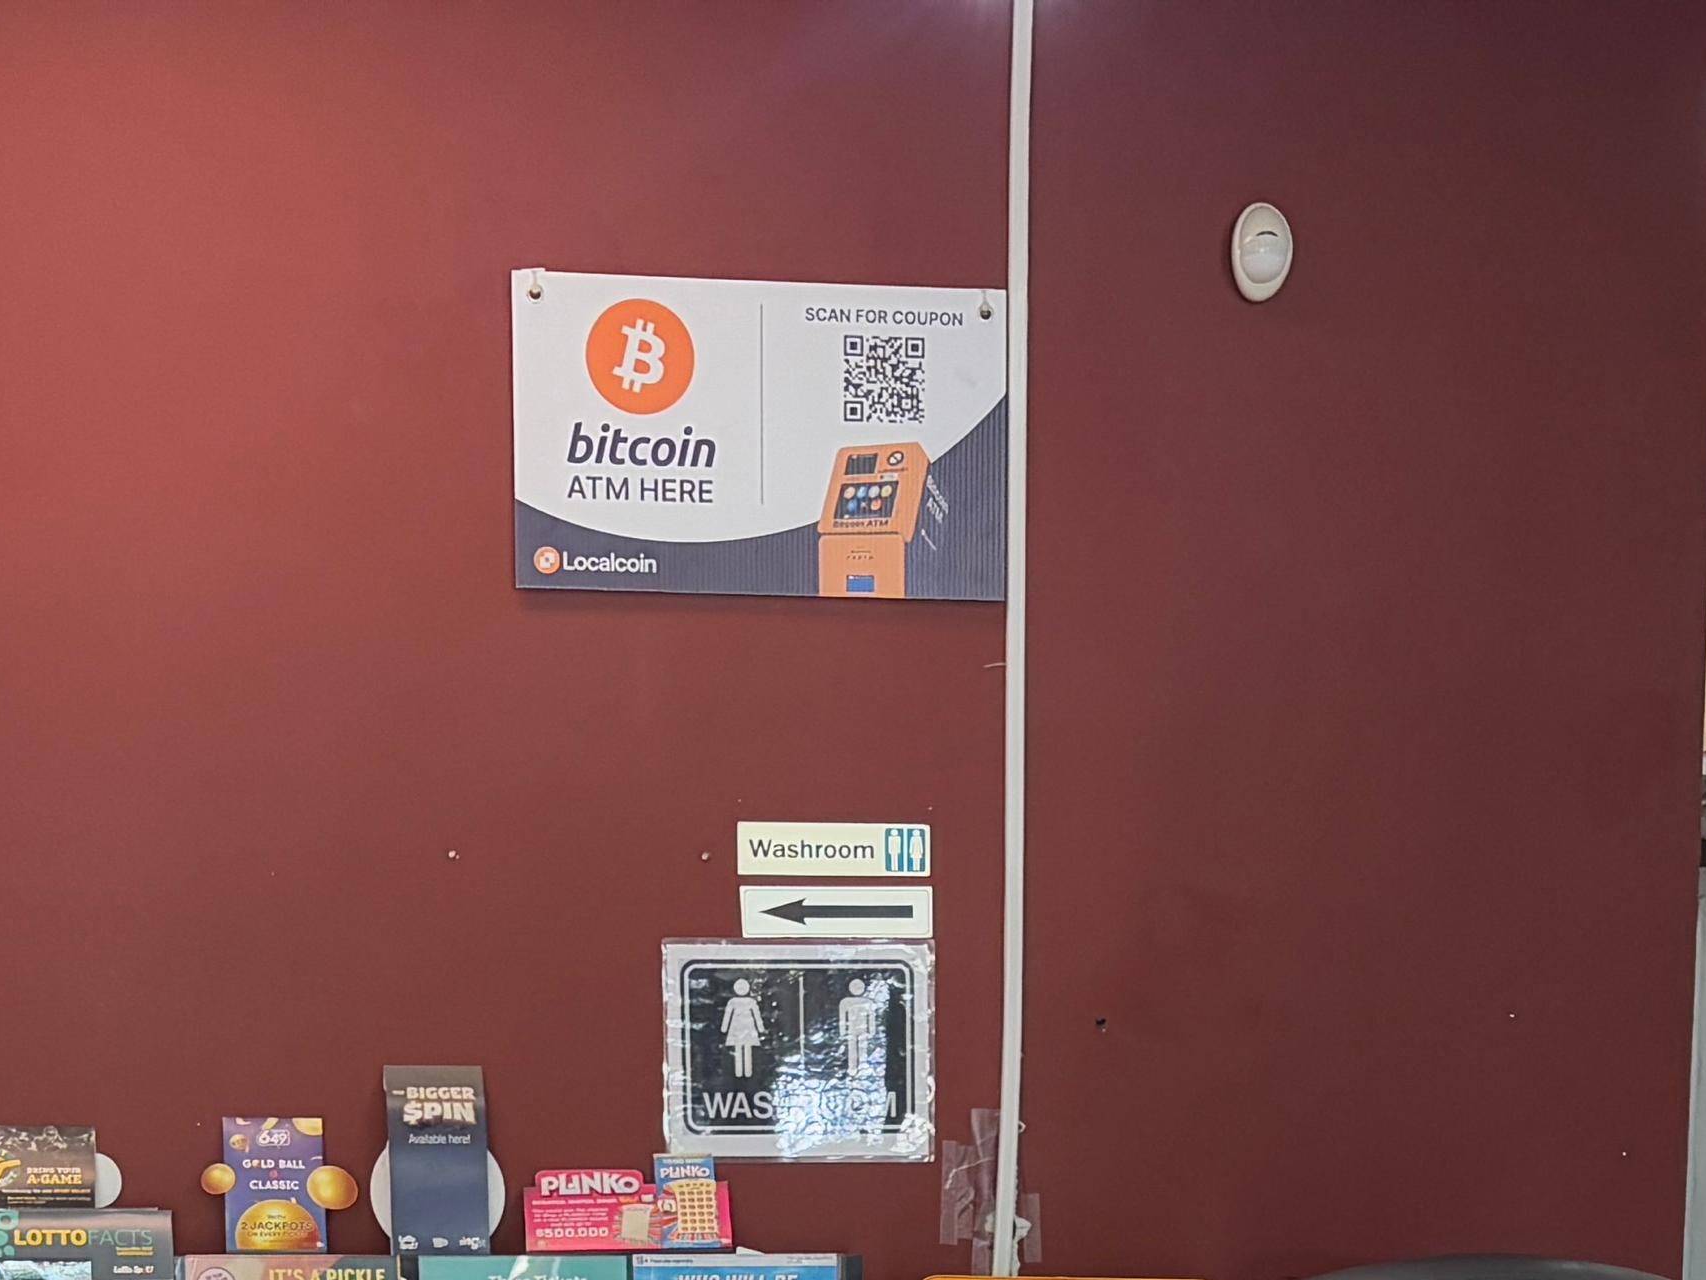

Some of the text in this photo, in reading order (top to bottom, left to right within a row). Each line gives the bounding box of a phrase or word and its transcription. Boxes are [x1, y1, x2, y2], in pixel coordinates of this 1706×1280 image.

[805, 308, 963, 326] SCAN FOR COUPON
[568, 423, 716, 468] bitcoin
[568, 476, 713, 503] ATM HERE
[563, 552, 657, 573] Localcoin
[749, 839, 875, 859] Washroom
[406, 1087, 475, 1100] BIGGER
[409, 1134, 470, 1145] Available here!
[243, 1159, 305, 1169] GOLD BALL
[660, 1166, 710, 1179] PLINKO
[249, 1180, 299, 1190] CLASSIC
[541, 1172, 640, 1196] PLINKO
[250, 1222, 313, 1231] JACKPOTS
